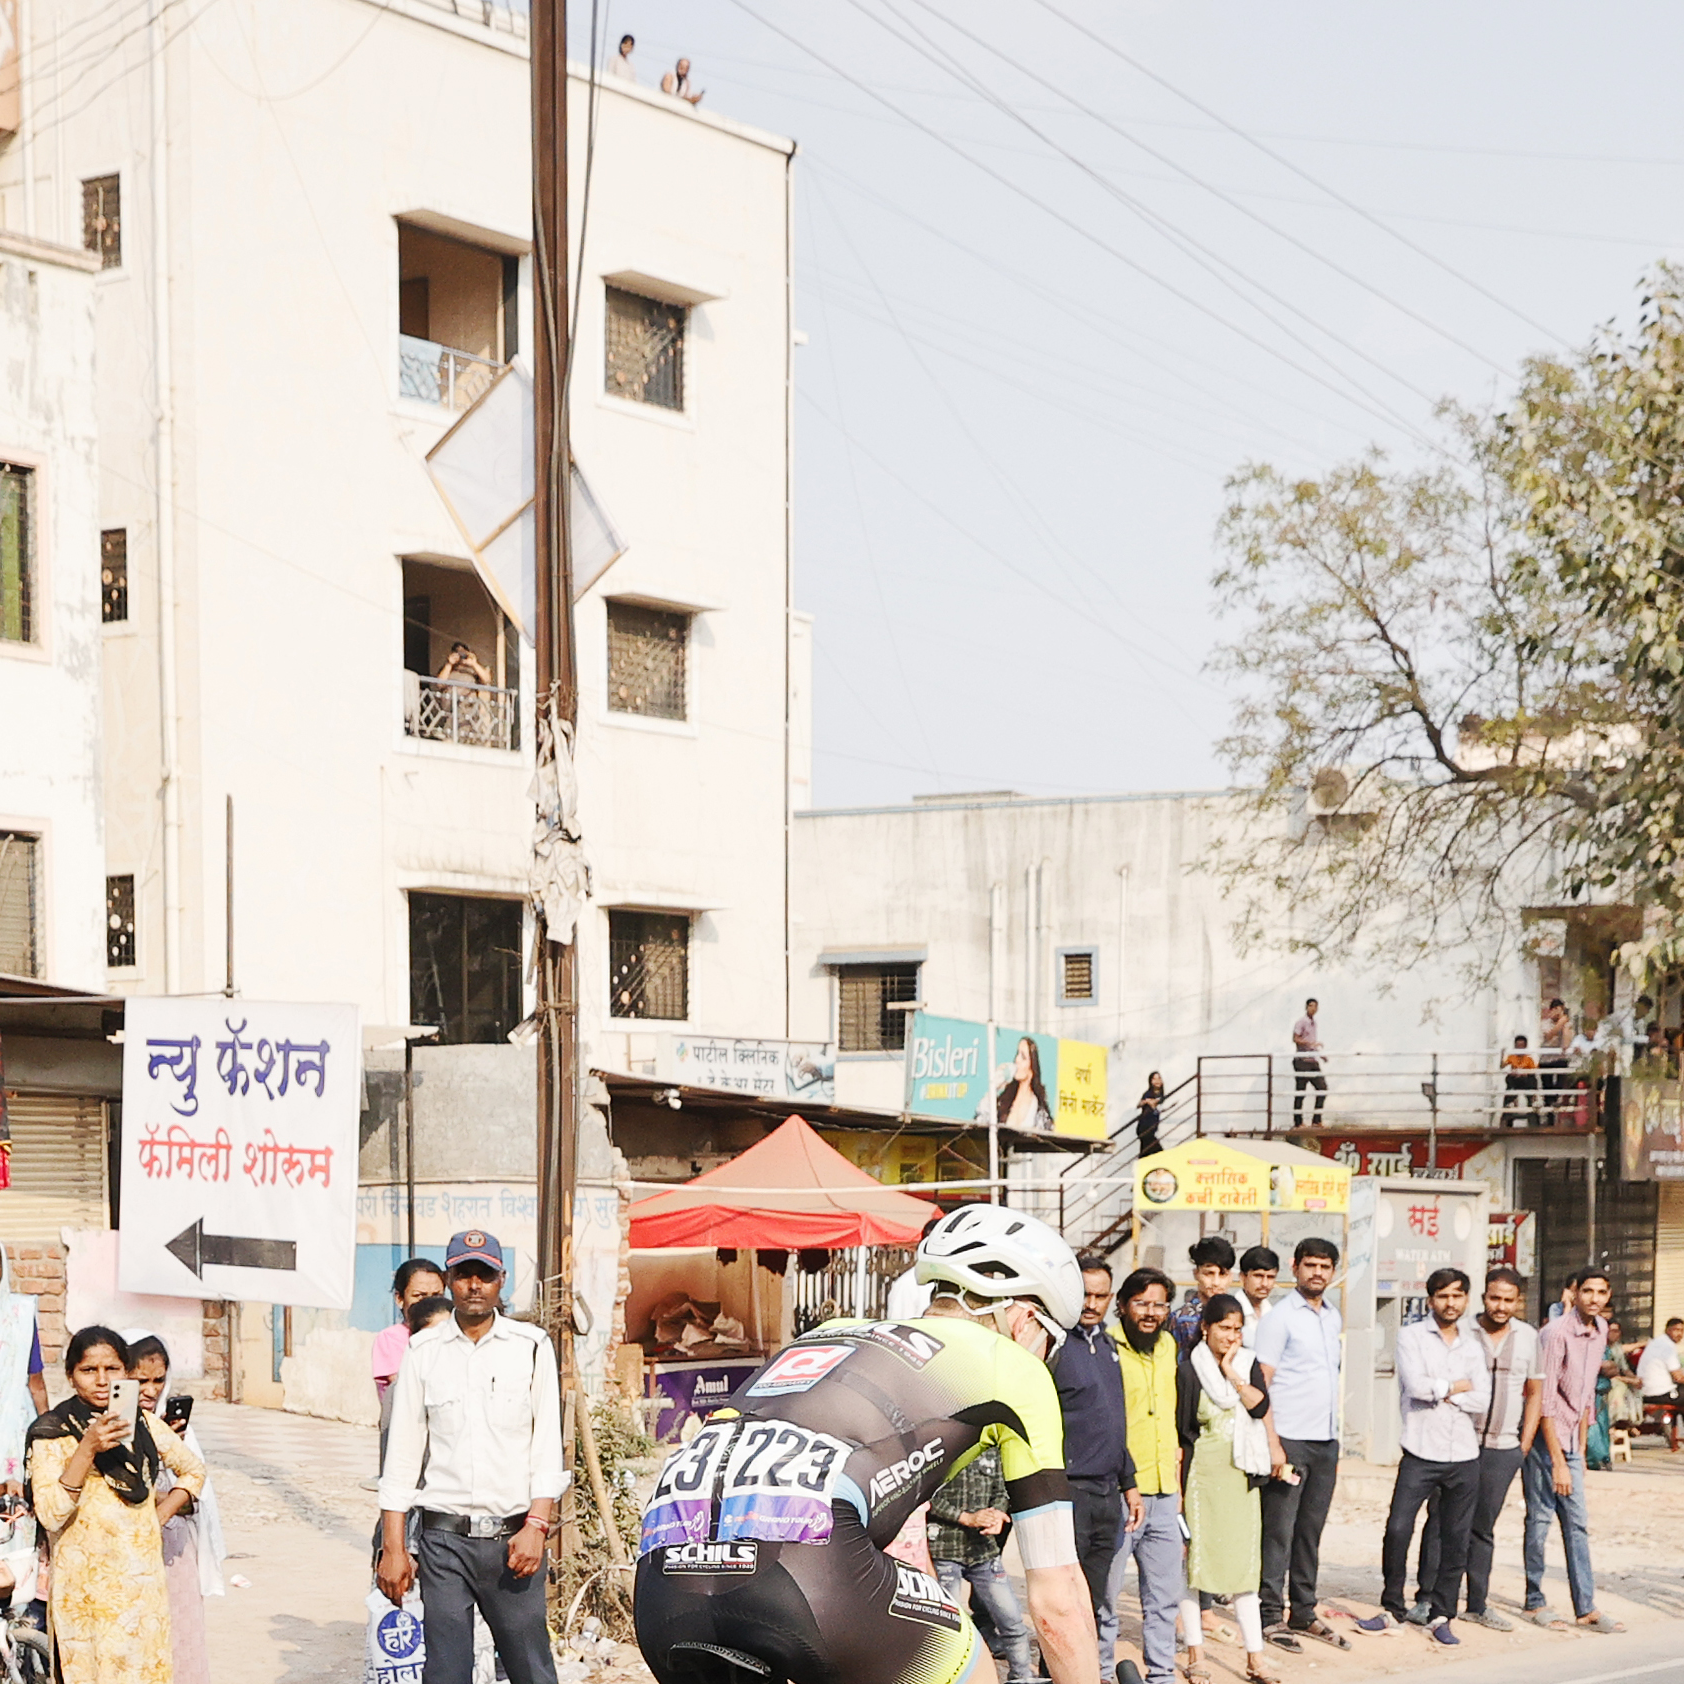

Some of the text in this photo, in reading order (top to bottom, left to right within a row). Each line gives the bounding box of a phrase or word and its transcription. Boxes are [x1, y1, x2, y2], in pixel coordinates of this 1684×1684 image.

[911, 1034, 980, 1079] Bisleri
[693, 1374, 729, 1397] Amul
[655, 1431, 721, 1500] 23
[733, 1427, 840, 1492] 223
[665, 1543, 756, 1564] SCHILS
[897, 1567, 960, 1610] SCHIL
